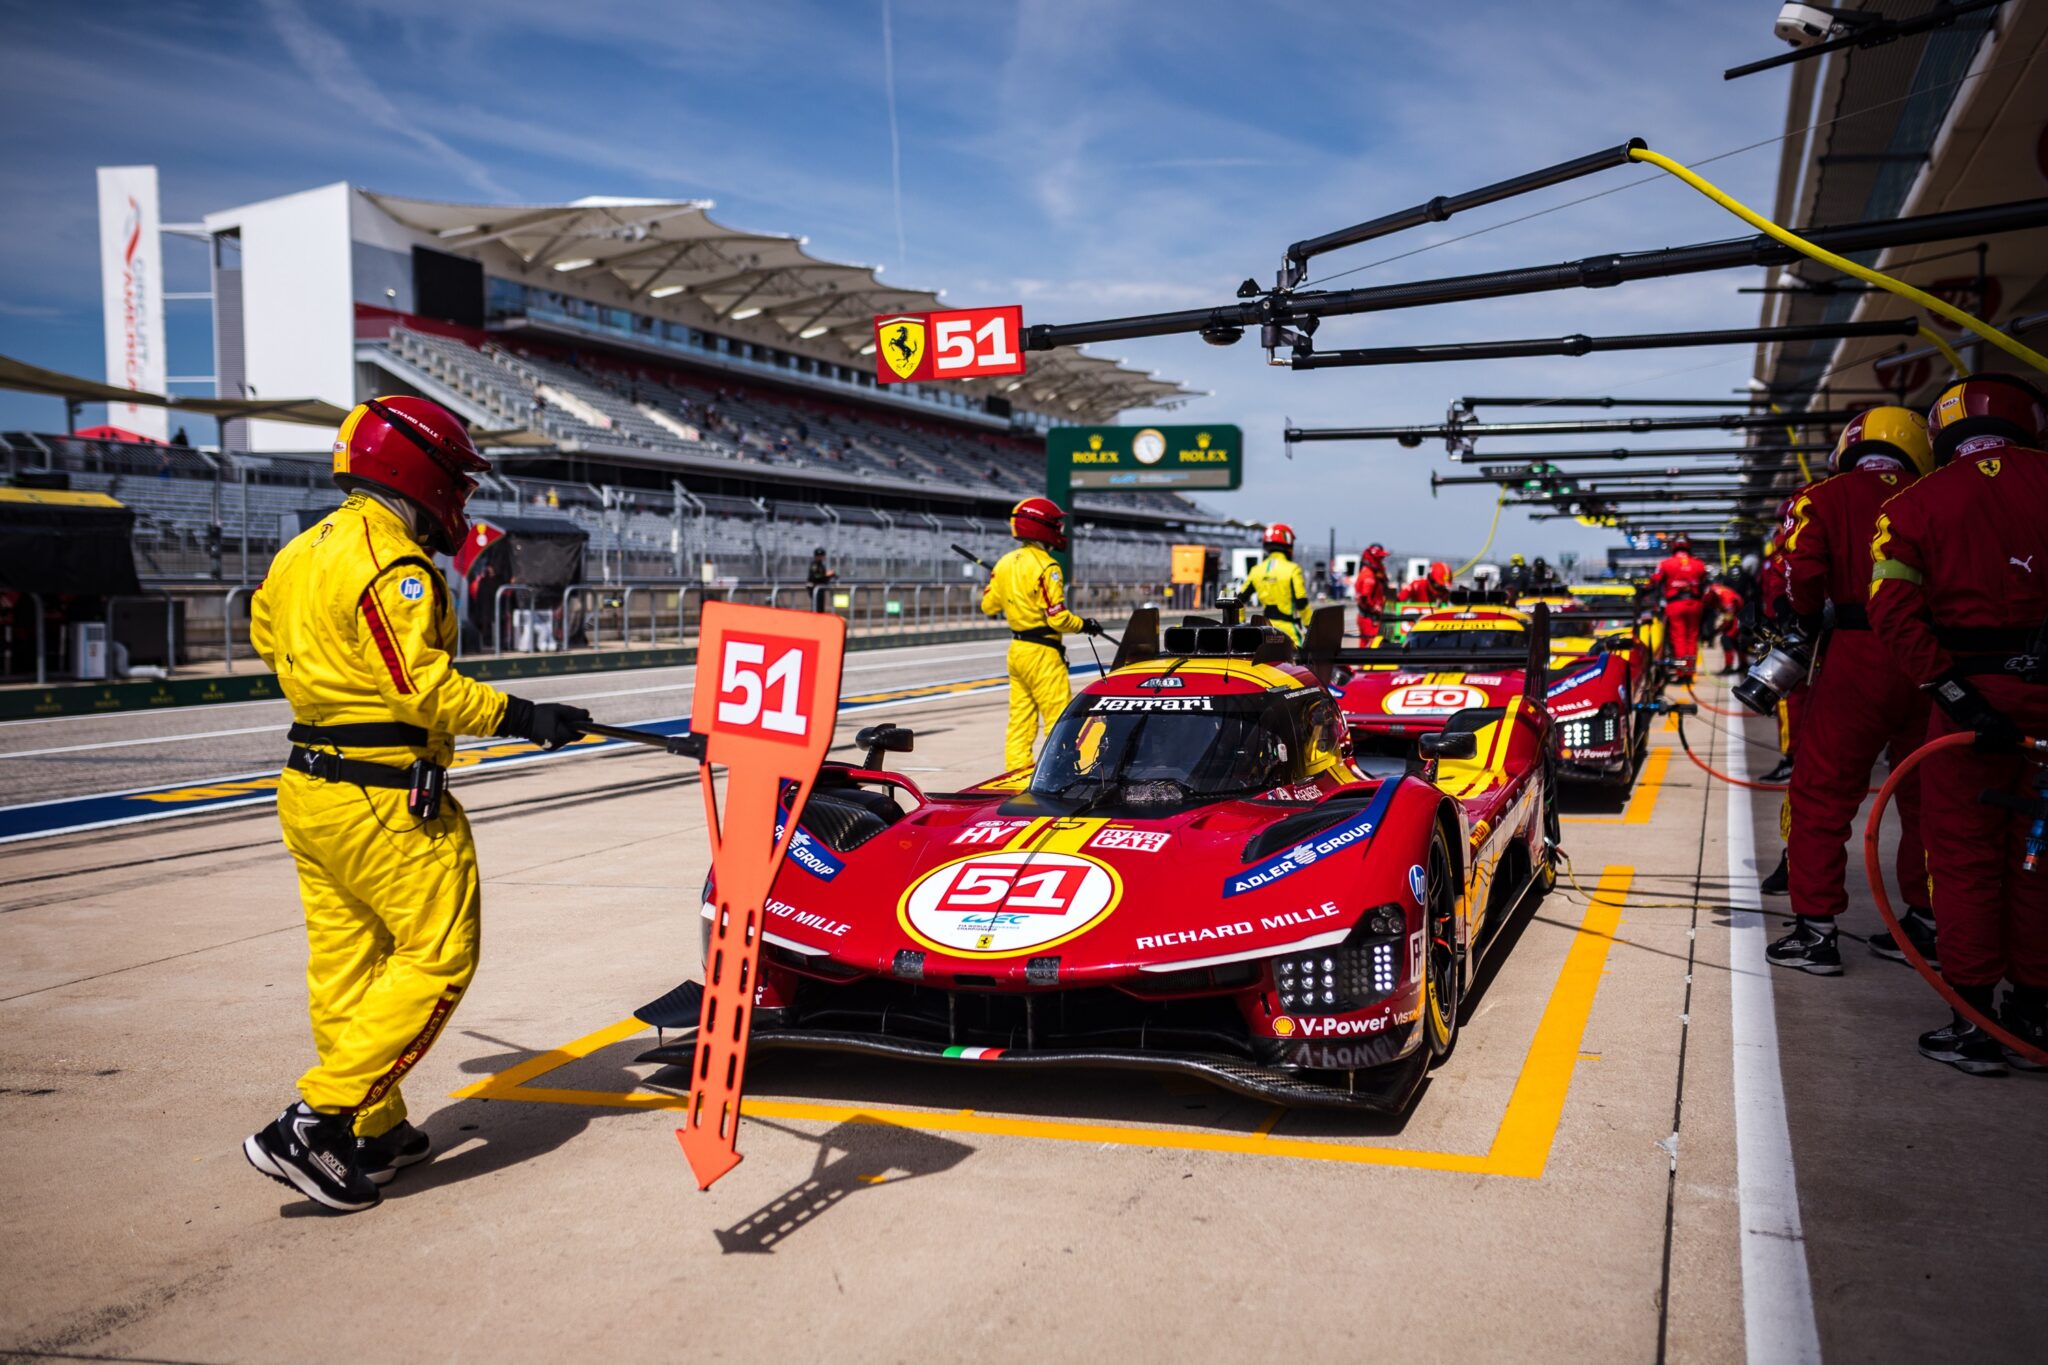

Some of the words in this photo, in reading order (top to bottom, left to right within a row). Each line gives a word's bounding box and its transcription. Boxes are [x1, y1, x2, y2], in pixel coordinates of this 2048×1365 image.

[935, 317, 1017, 370] 51
[418, 422, 438, 438] MILLE
[1072, 452, 1119, 463] ROLEX
[1179, 450, 1228, 462] ROLEX
[403, 579, 421, 600] hp
[718, 640, 807, 736] 51
[1089, 696, 1214, 711] Ferrari
[1404, 690, 1466, 706] 50
[1573, 749, 1612, 759] V-Power
[953, 827, 1018, 844] HY
[1096, 836, 1159, 850] CAR
[1103, 830, 1165, 840] HYPER
[793, 847, 835, 876] GROUP
[1235, 860, 1297, 893] ADLER
[1315, 822, 1373, 854] GROUP
[946, 867, 1068, 908] 51
[1413, 867, 1425, 905] hp
[791, 910, 852, 937] MILLE
[961, 913, 1030, 925] WEC
[1135, 921, 1253, 950] RICHARD
[1260, 901, 1340, 930] MILLE
[1299, 1015, 1390, 1036] V-Power
